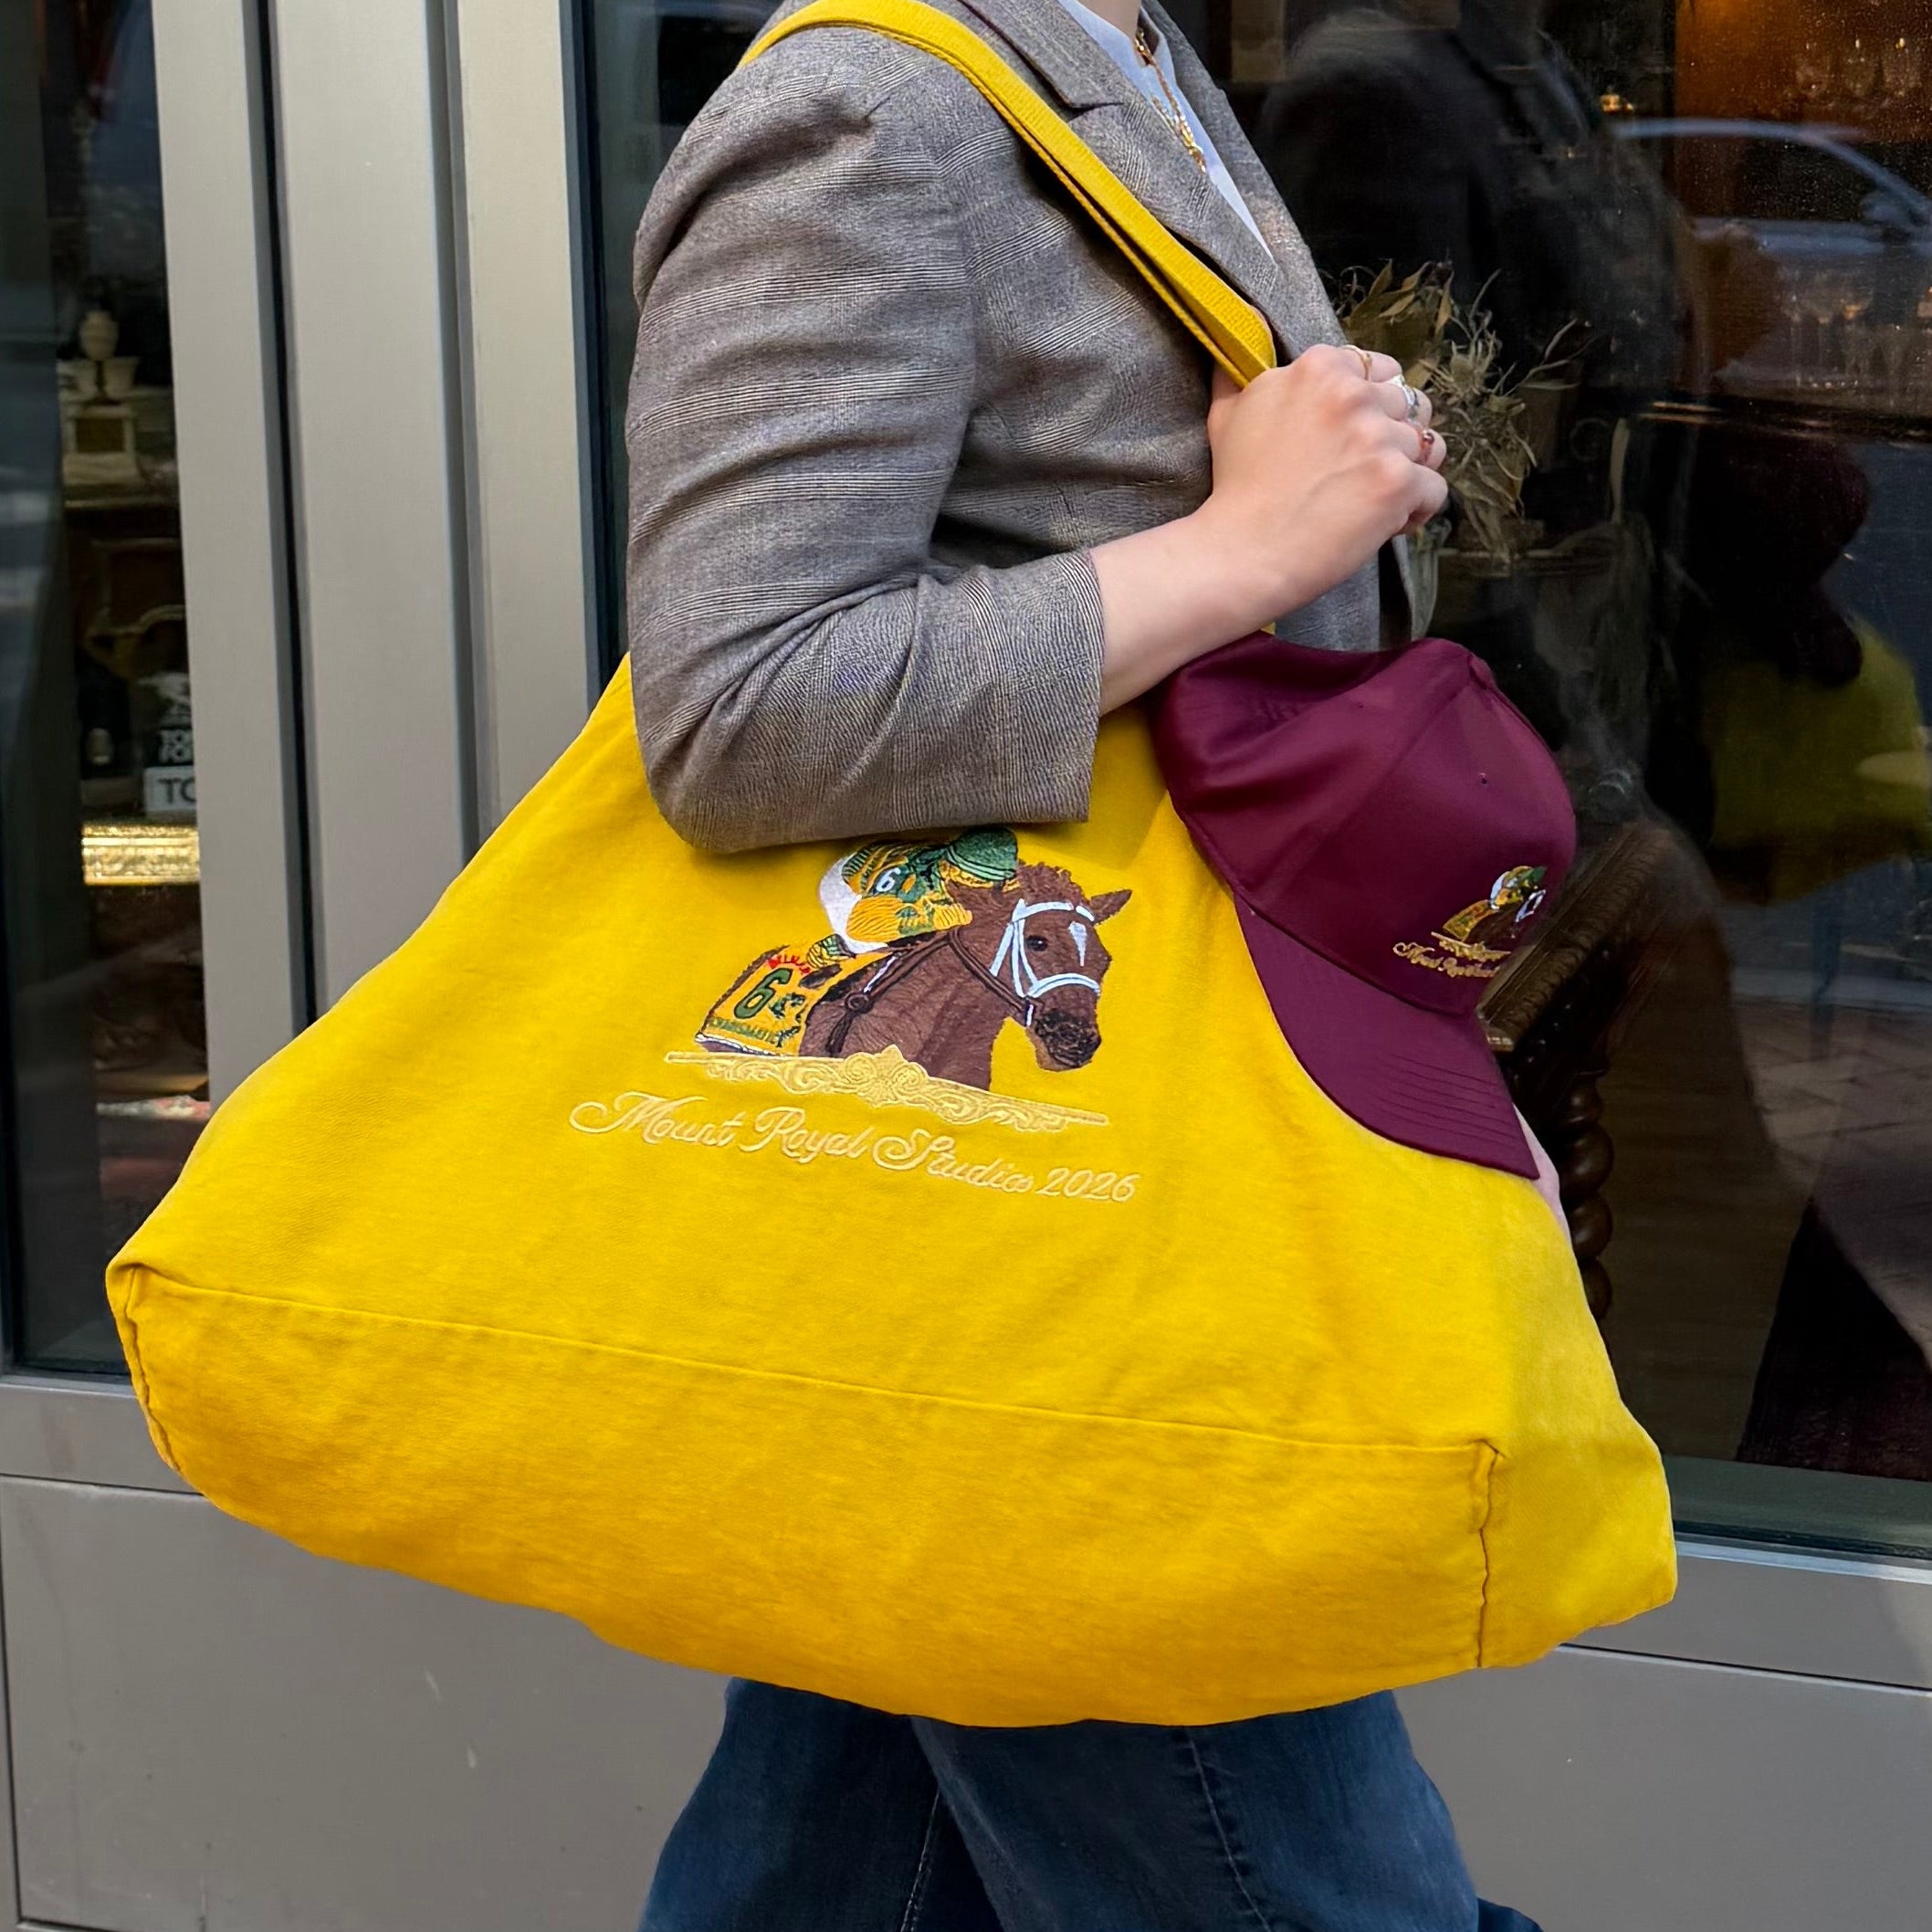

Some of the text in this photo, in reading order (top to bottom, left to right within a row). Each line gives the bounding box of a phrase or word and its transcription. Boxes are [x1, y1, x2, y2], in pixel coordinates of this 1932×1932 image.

[875, 866, 902, 893] 6
[733, 967, 793, 1020] 6
[568, 1090, 1140, 1202] Mount Royal Studios 2026
